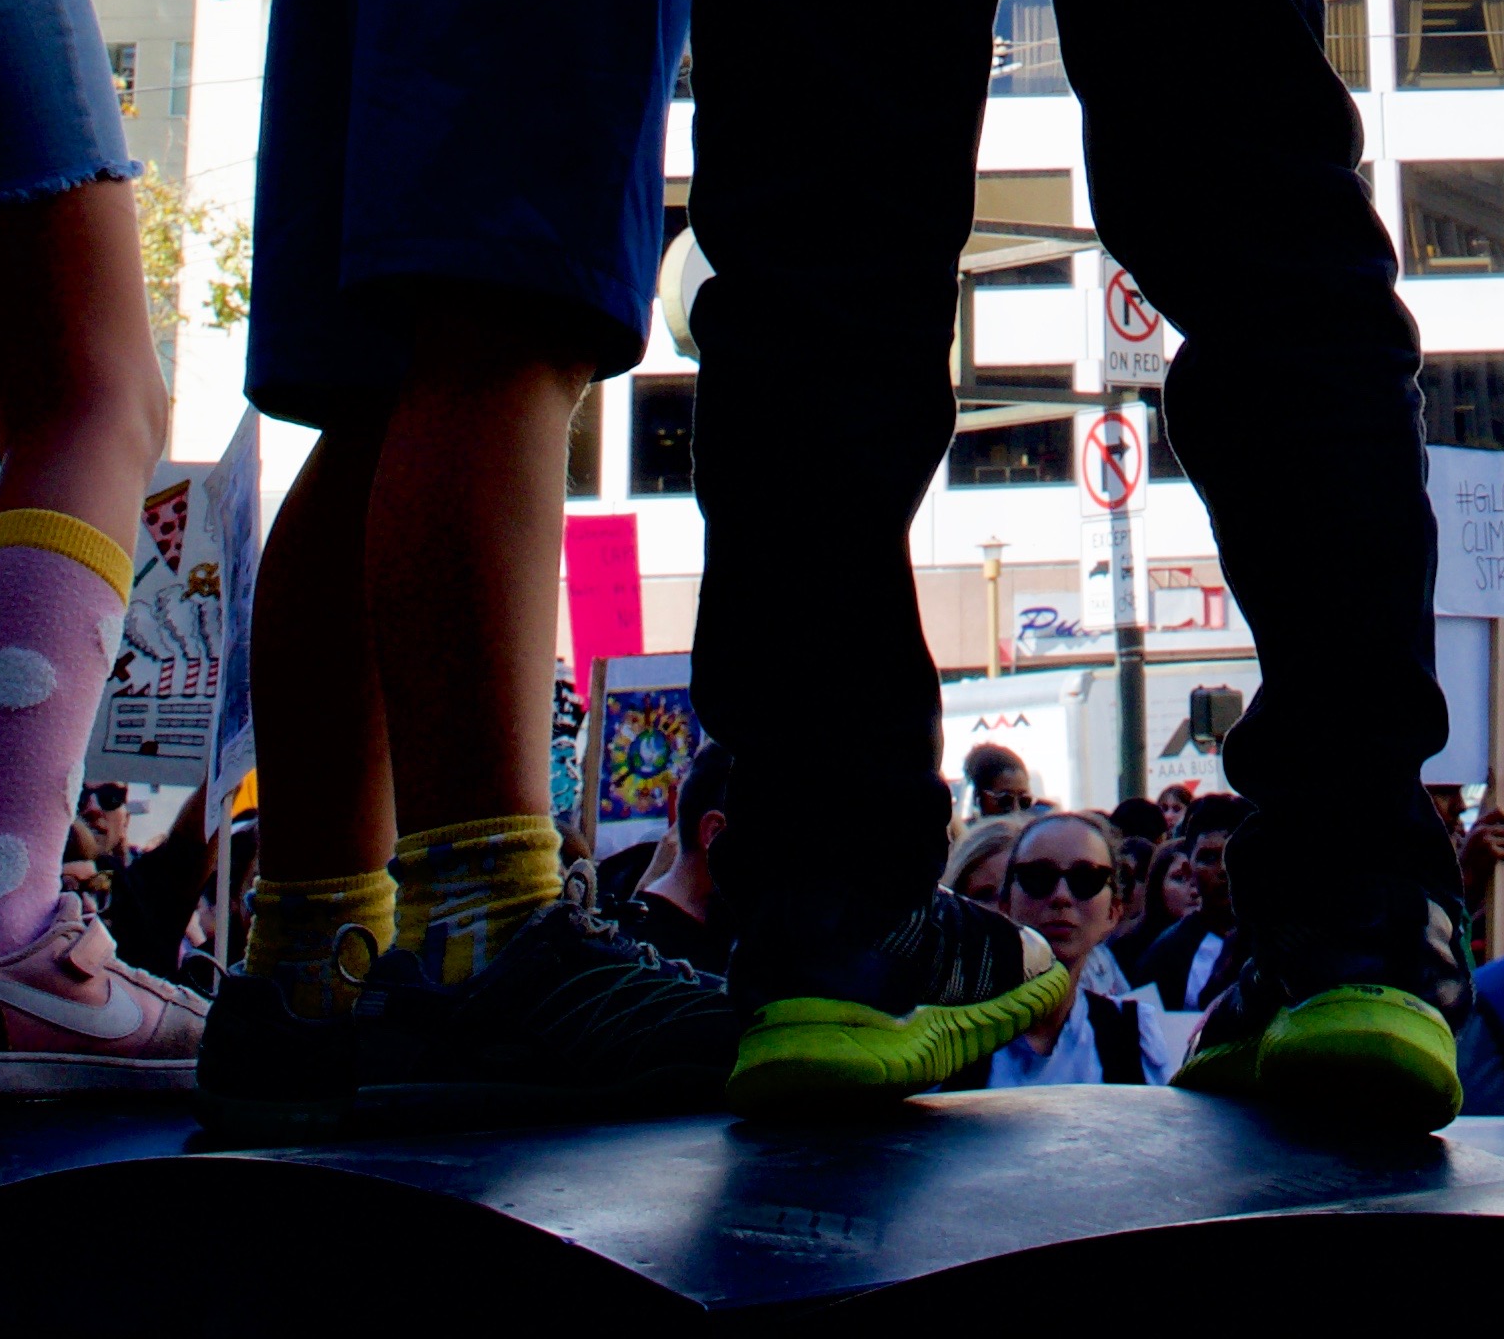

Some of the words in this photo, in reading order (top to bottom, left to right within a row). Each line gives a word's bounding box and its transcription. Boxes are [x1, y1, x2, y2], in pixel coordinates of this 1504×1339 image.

[1109, 351, 1129, 372] ON
[1132, 352, 1161, 373] RED
[1091, 529, 1134, 551] EXCEPT
[1158, 761, 1187, 778] AAA
